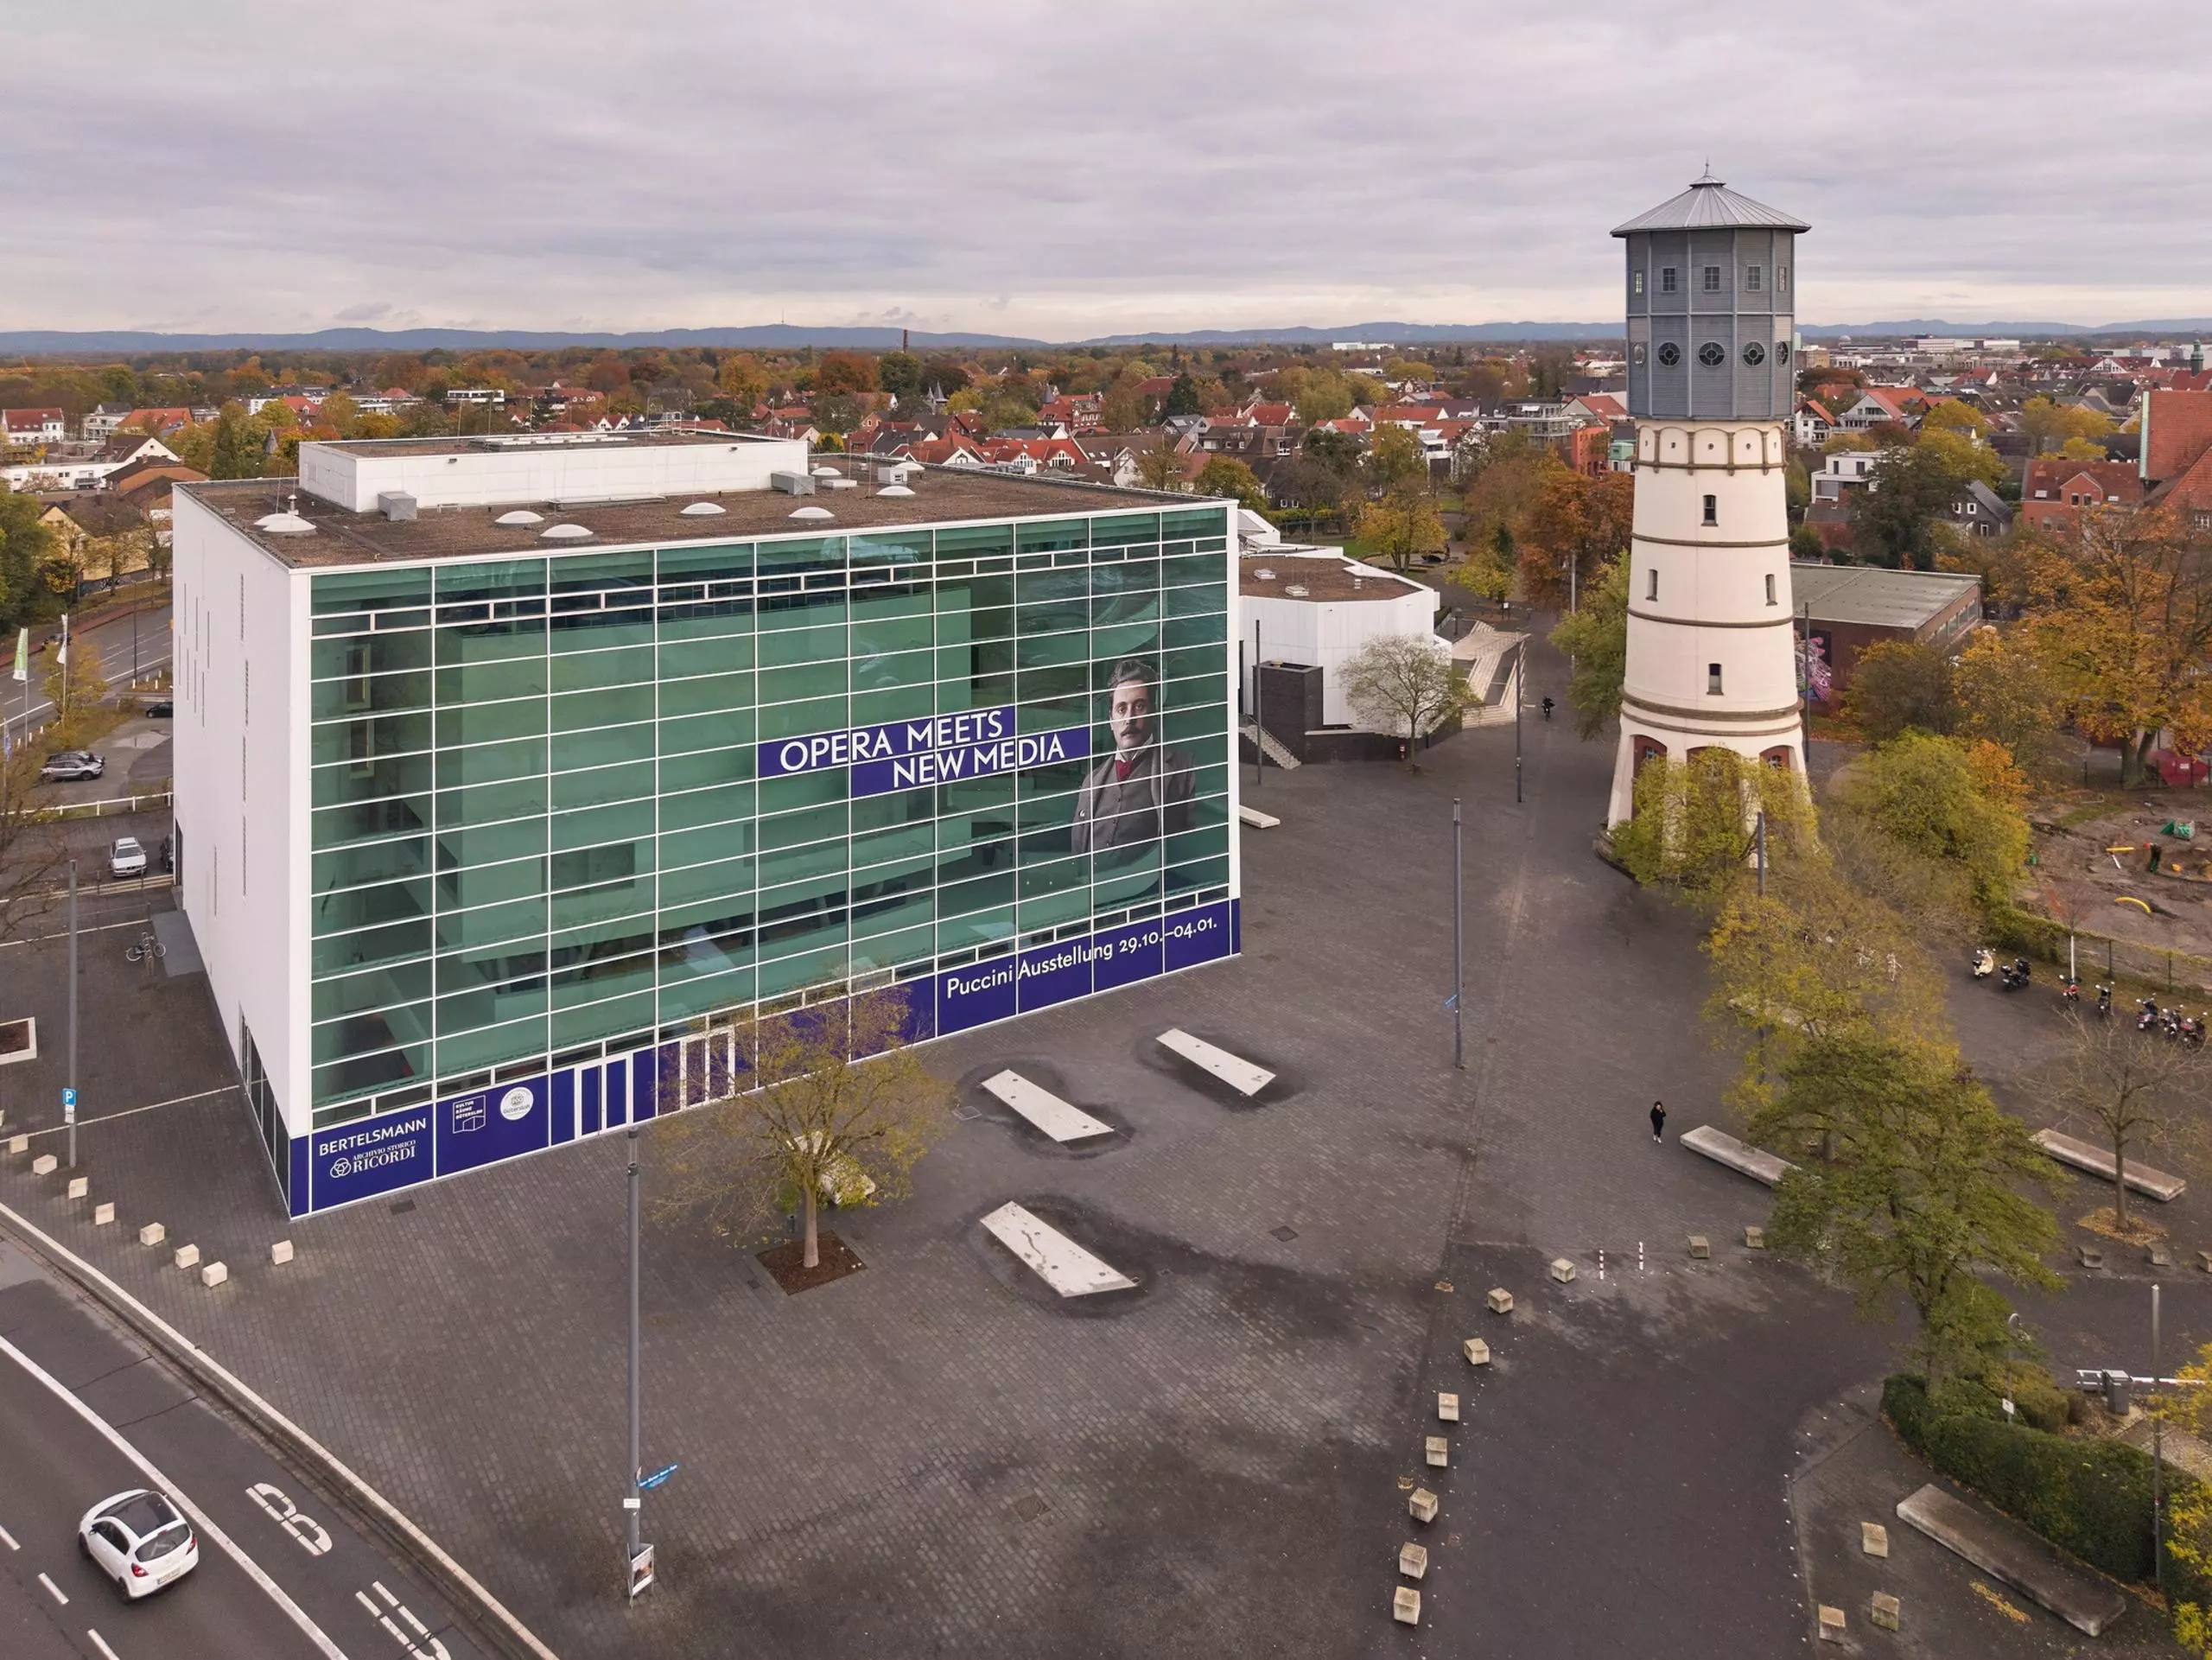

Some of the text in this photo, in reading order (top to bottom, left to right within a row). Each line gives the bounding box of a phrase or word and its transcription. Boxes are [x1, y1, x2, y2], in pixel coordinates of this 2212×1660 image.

[779, 710, 1003, 772] OPERA MEETS
[893, 734, 1065, 788] NEW MEDIA
[947, 964, 1014, 999] Puccini
[1017, 943, 1114, 981] Ausstellung
[65, 1091, 73, 1103] P
[319, 1117, 427, 1156] BERTELSMANN
[353, 1139, 416, 1161] ARCHIVIO STORICO
[353, 1146, 416, 1173] RICORDI
